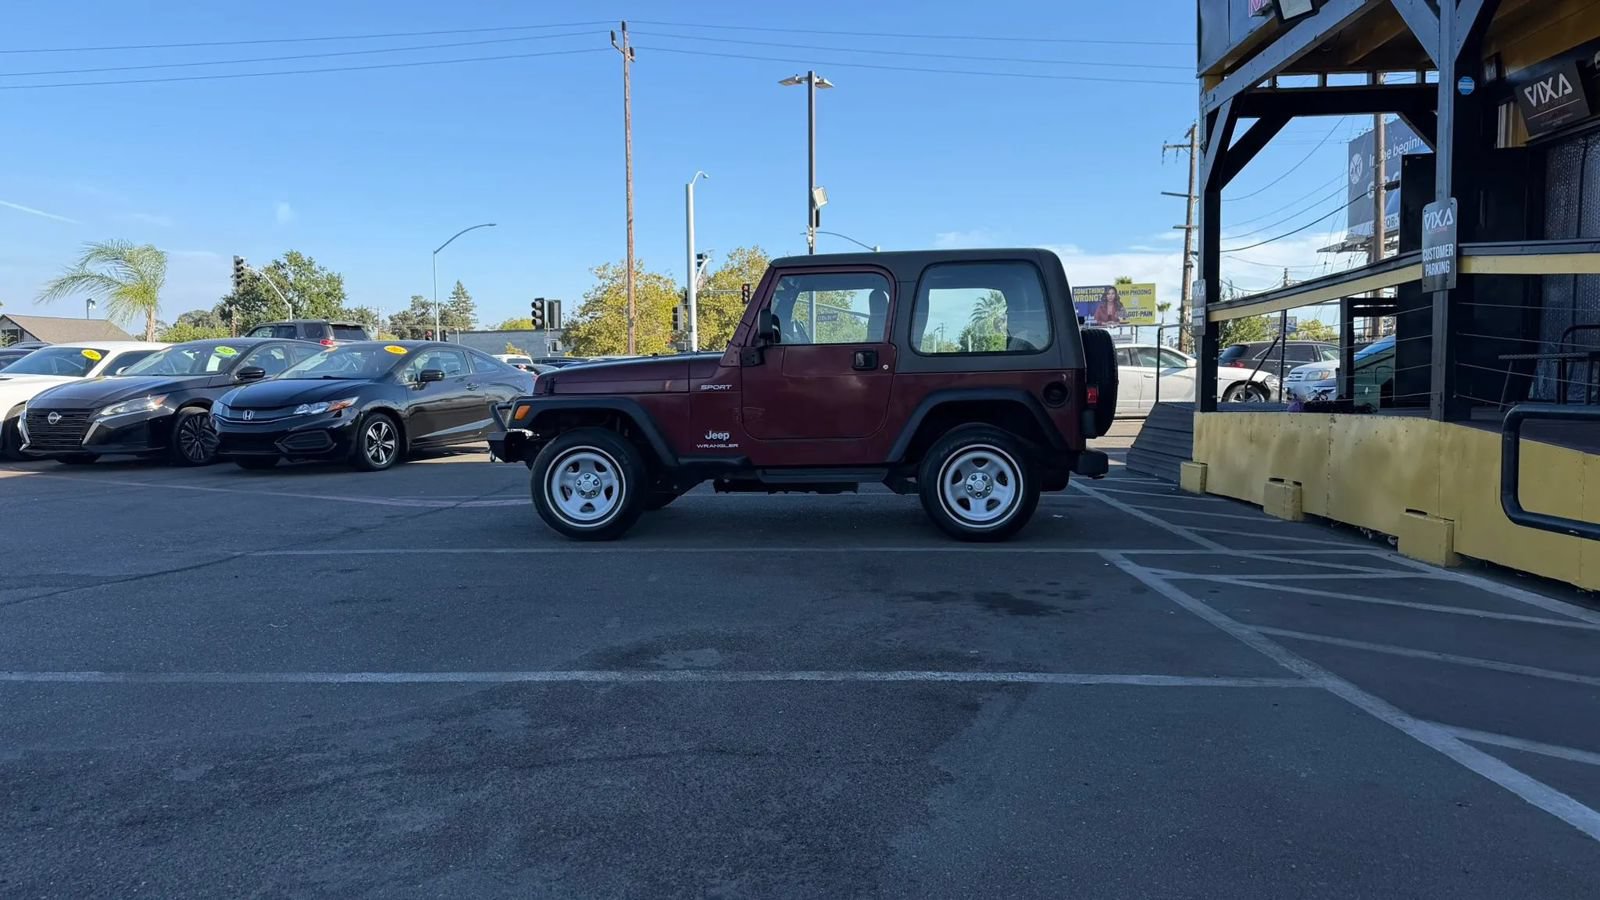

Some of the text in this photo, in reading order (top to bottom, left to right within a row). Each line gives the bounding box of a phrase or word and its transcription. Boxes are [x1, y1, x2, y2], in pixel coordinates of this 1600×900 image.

[1523, 72, 1573, 107] VIXA
[1424, 207, 1454, 231] VIXA
[1422, 243, 1453, 262] CUSTOMER
[1425, 260, 1450, 277] PARKING
[1074, 294, 1103, 303] WRONG?
[704, 430, 730, 441] Jeep
